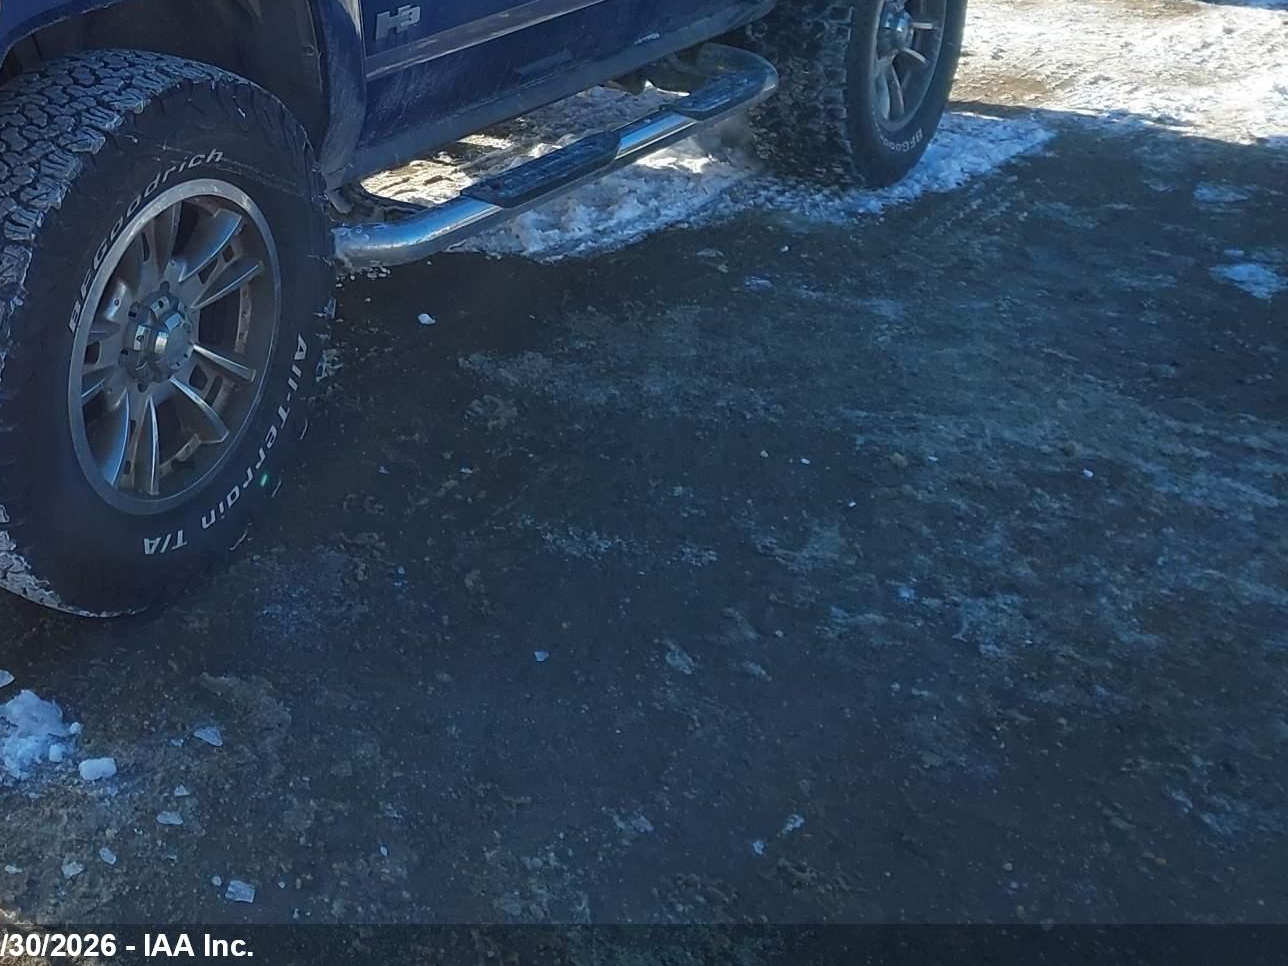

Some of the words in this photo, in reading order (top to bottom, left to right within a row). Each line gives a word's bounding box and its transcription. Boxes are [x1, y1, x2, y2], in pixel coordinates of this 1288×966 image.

[69, 148, 224, 332] BFGoodrich
[201, 334, 308, 529] All-Terrain
[143, 529, 188, 555] T/A
